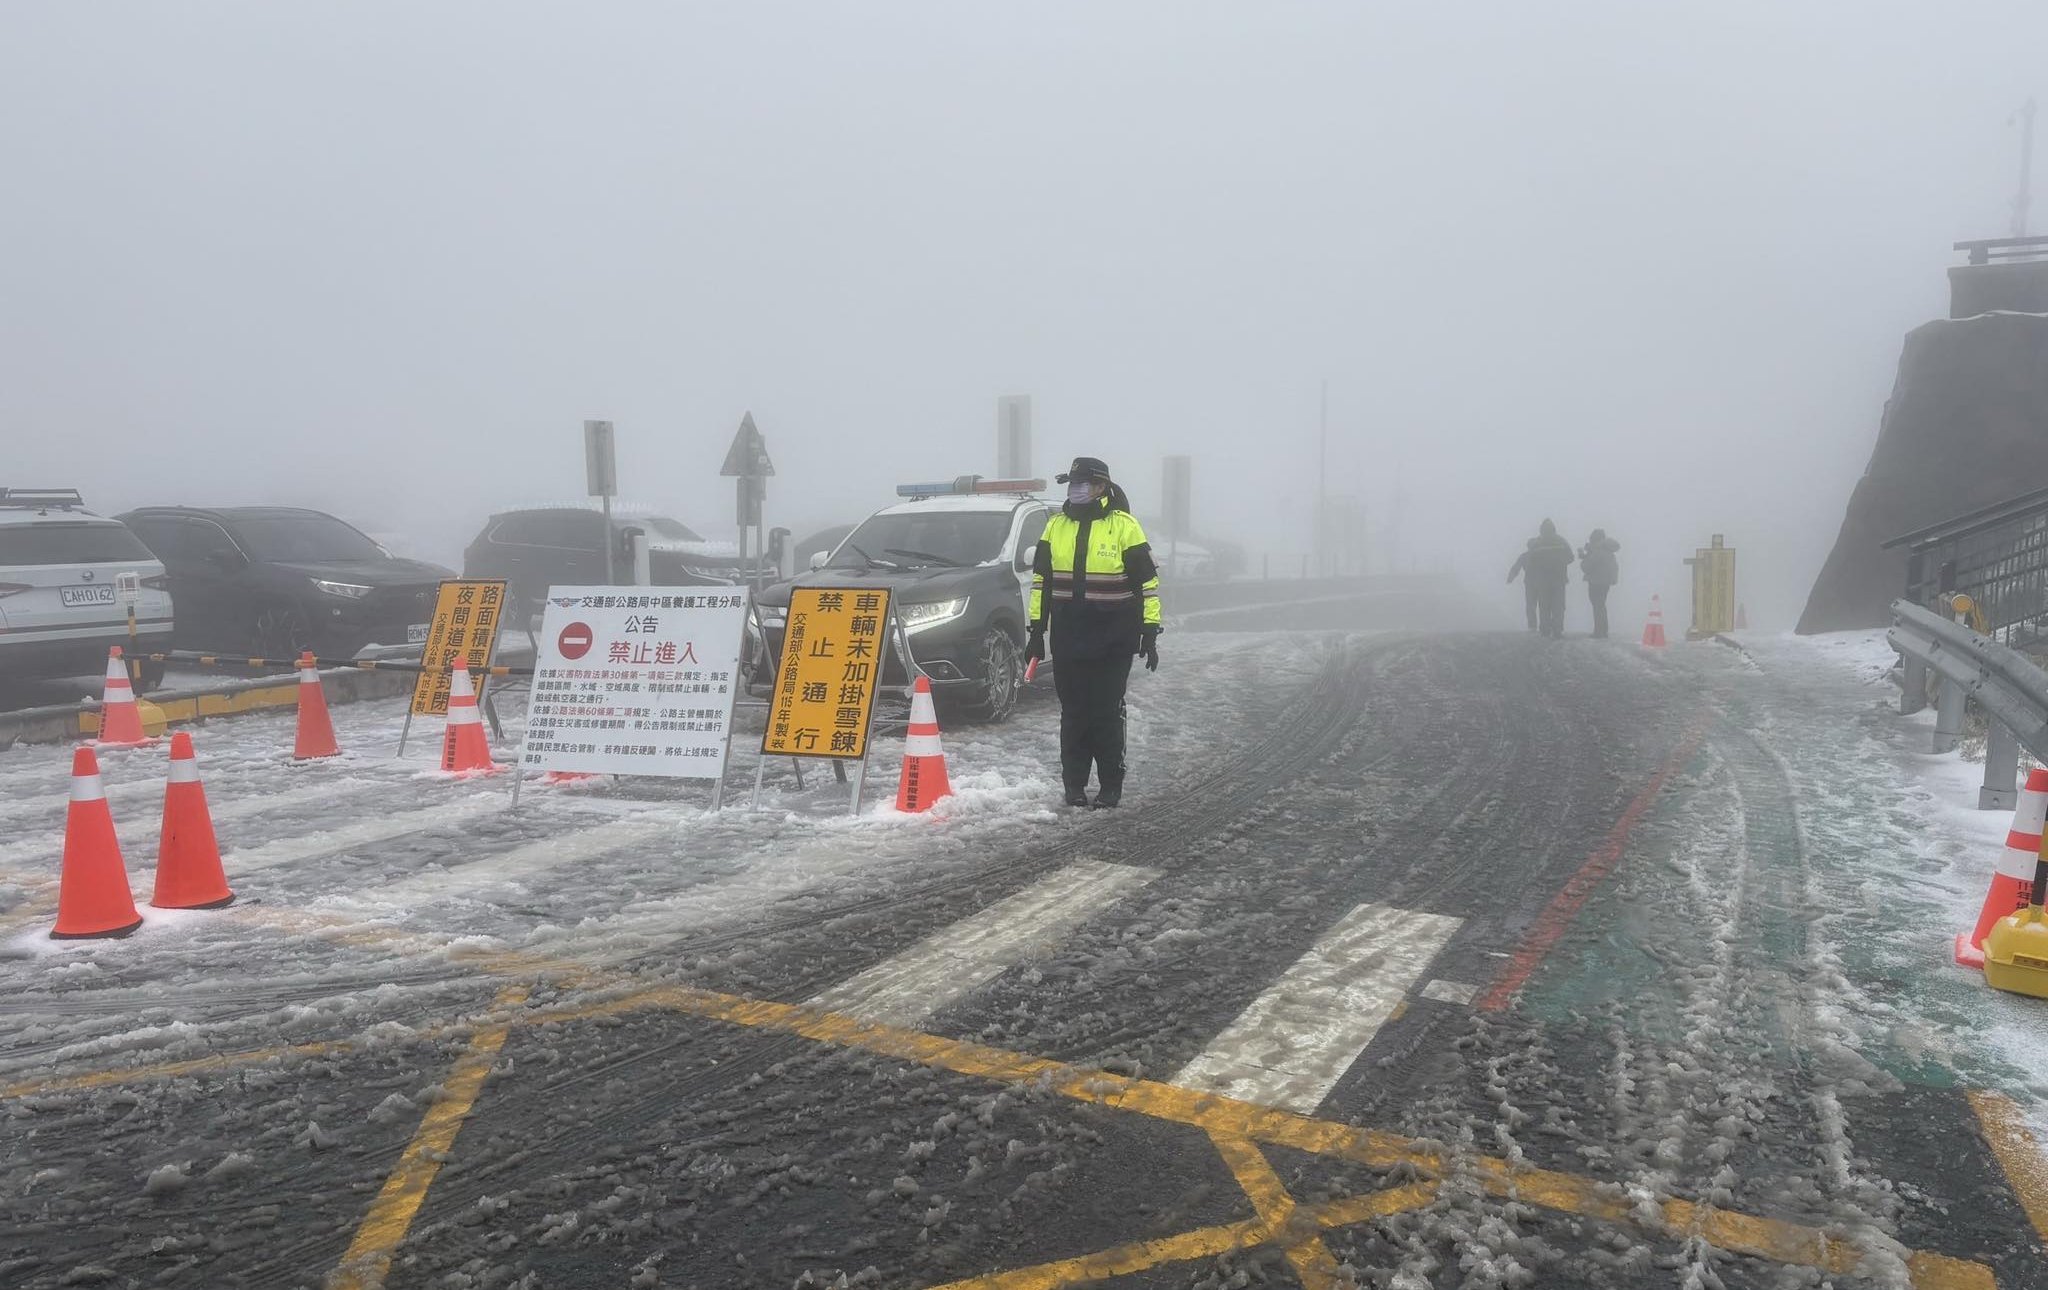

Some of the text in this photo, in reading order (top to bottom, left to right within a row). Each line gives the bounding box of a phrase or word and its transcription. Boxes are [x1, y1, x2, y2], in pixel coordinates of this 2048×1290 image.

[581, 596, 742, 609] 交通部公路局中區養護工程分局
[624, 615, 659, 634] 公告
[608, 641, 698, 665] 禁止進入
[794, 592, 844, 750] 禁止通行
[830, 593, 881, 752] 車輛未加掛雪鍊
